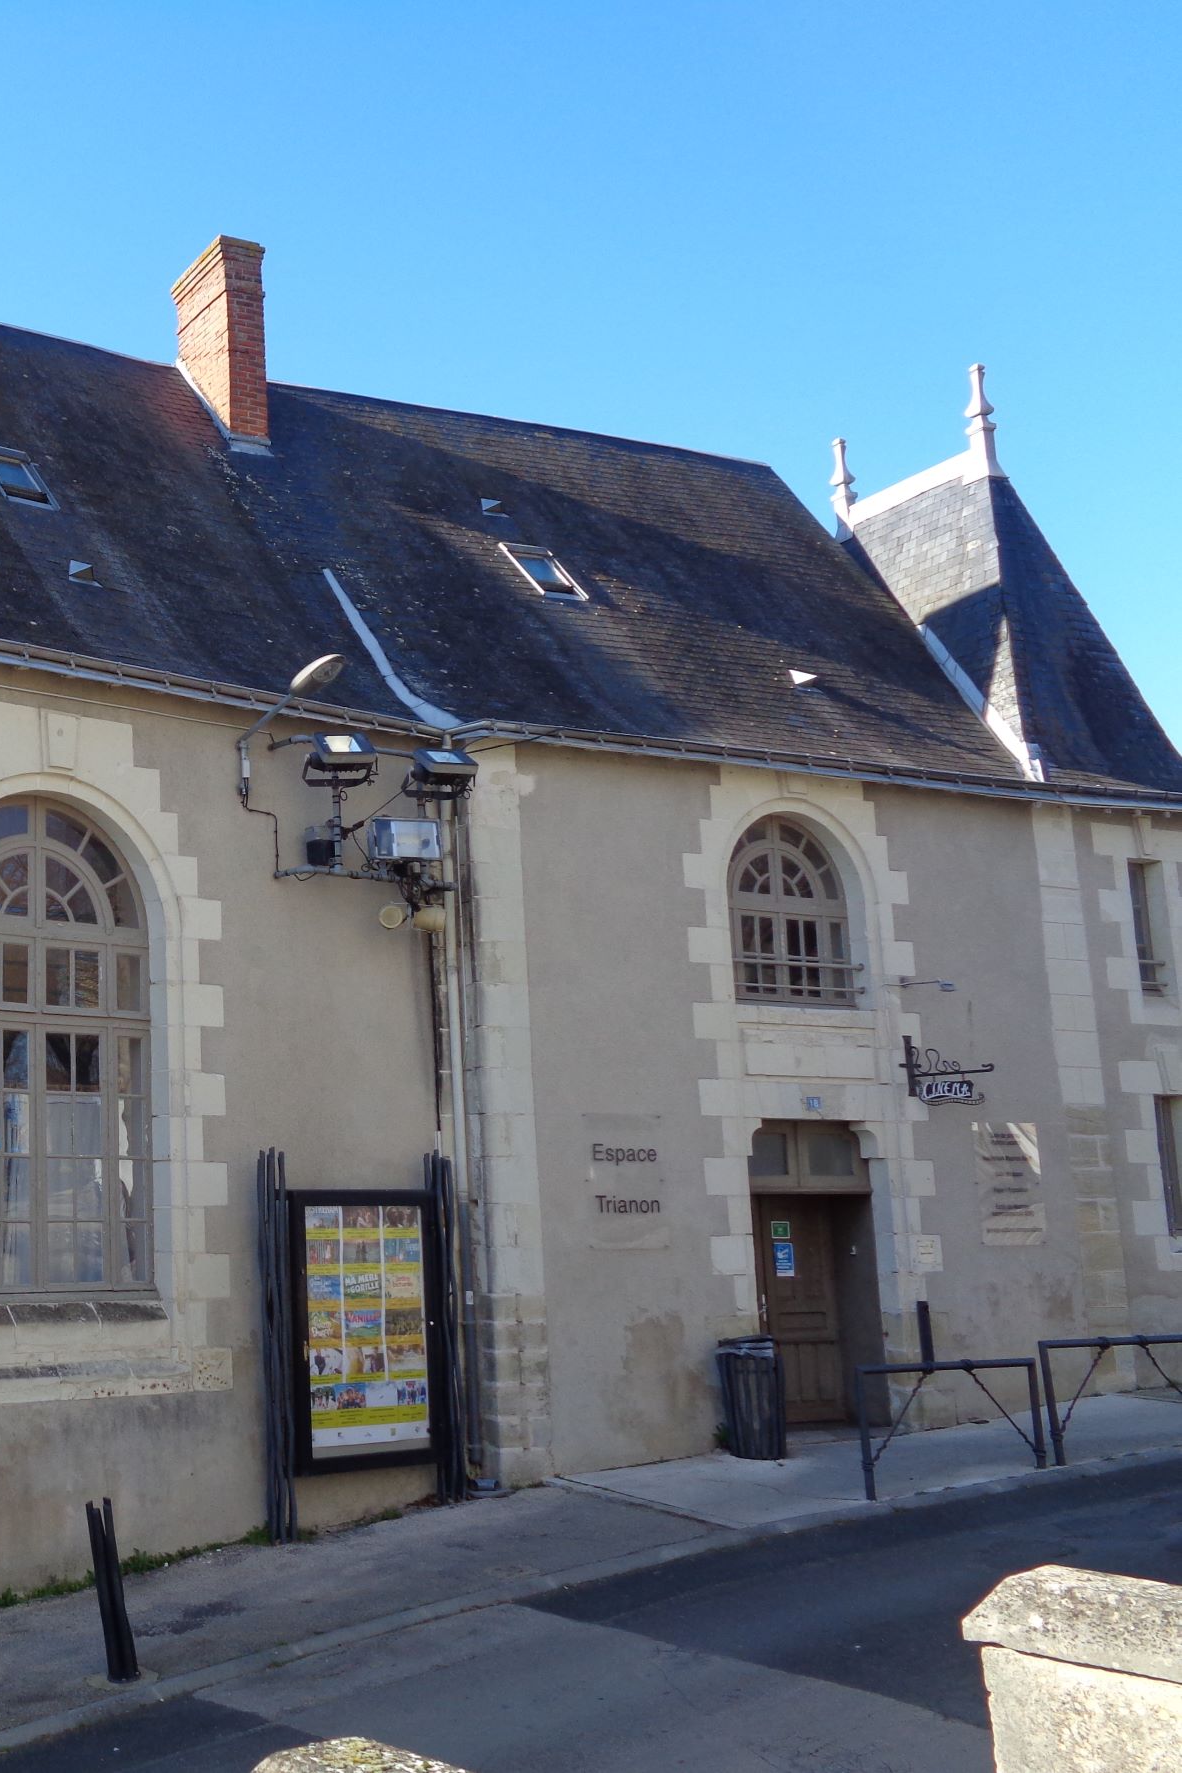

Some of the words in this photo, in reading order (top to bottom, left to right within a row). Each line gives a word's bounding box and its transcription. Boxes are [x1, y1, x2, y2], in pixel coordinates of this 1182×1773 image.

[922, 1081, 970, 1098] CINEMA
[592, 1143, 657, 1166] Espace
[595, 1195, 660, 1213] Trianon
